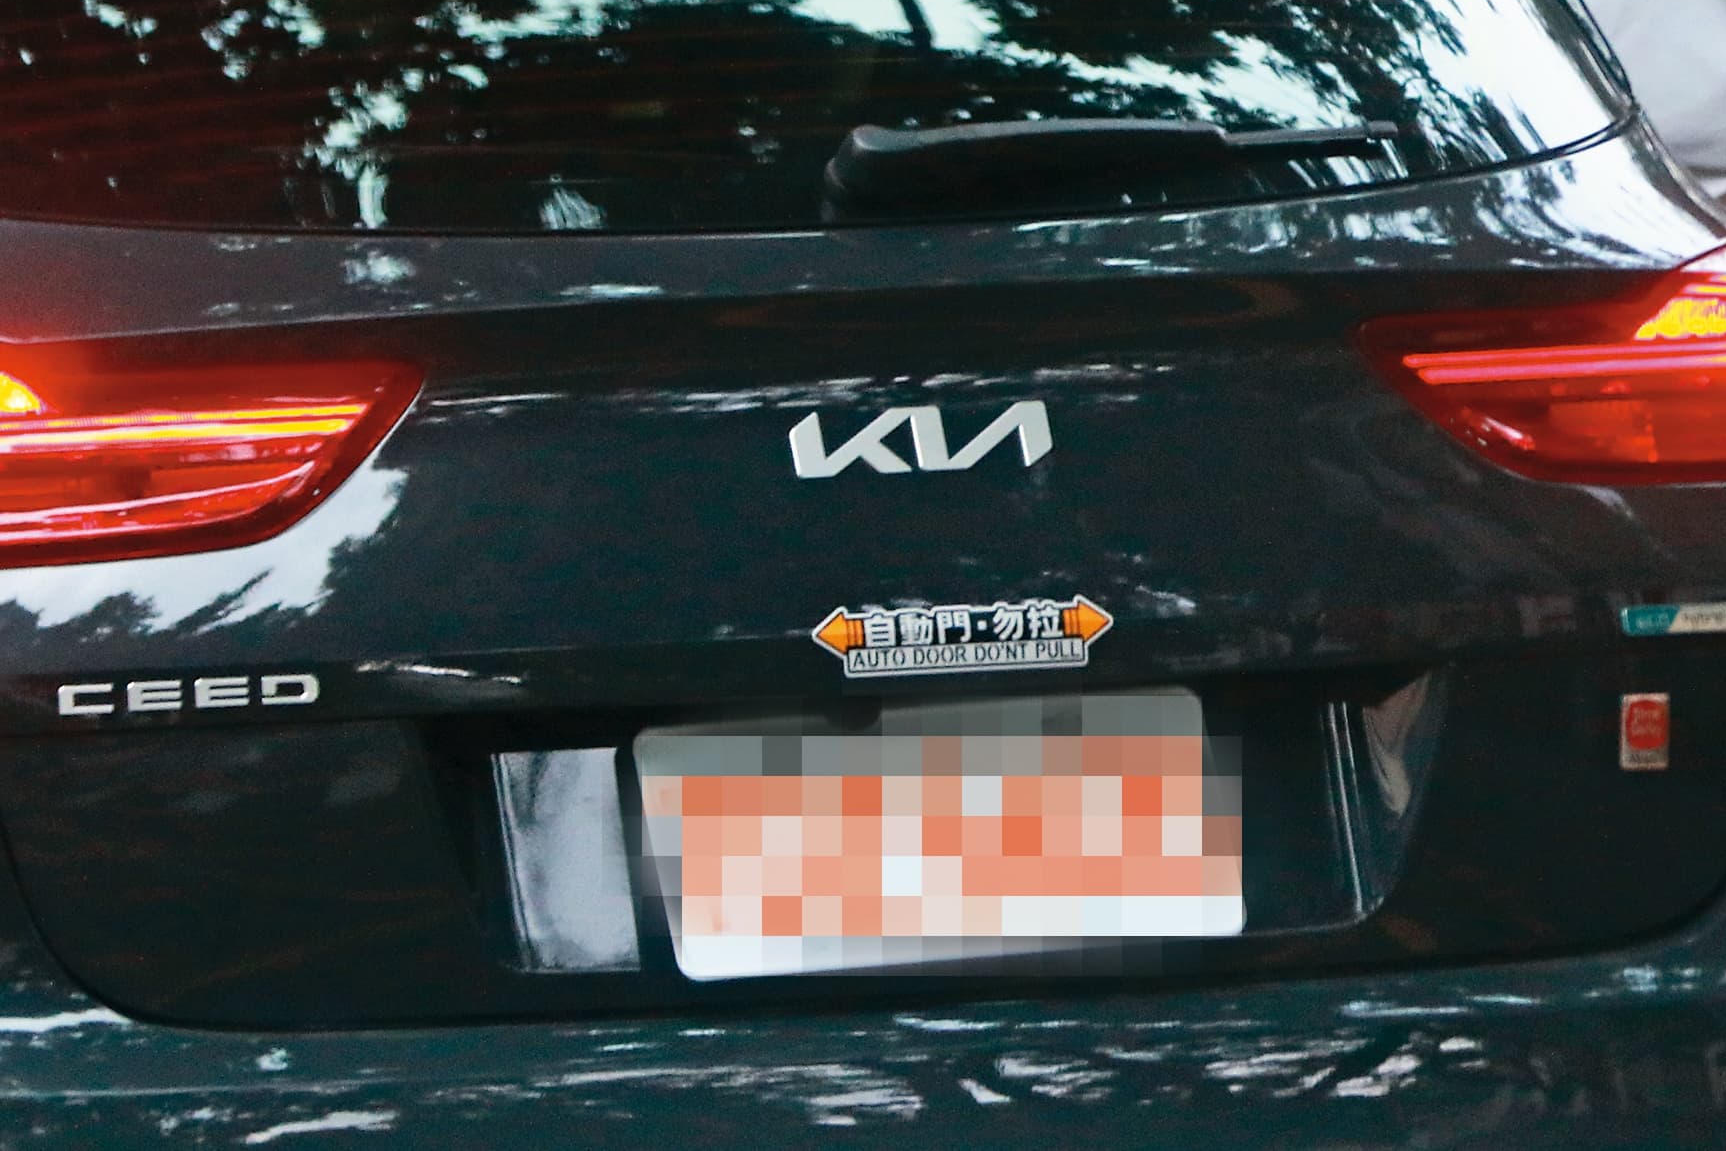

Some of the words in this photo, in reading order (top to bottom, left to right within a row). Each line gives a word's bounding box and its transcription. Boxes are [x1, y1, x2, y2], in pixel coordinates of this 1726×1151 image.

[789, 400, 1054, 478] KIA
[852, 649, 906, 668] AUTO
[912, 645, 967, 665] DOOR
[974, 641, 1026, 662] DO'NT
[1035, 639, 1080, 659] PULL
[57, 674, 320, 716] CEED
